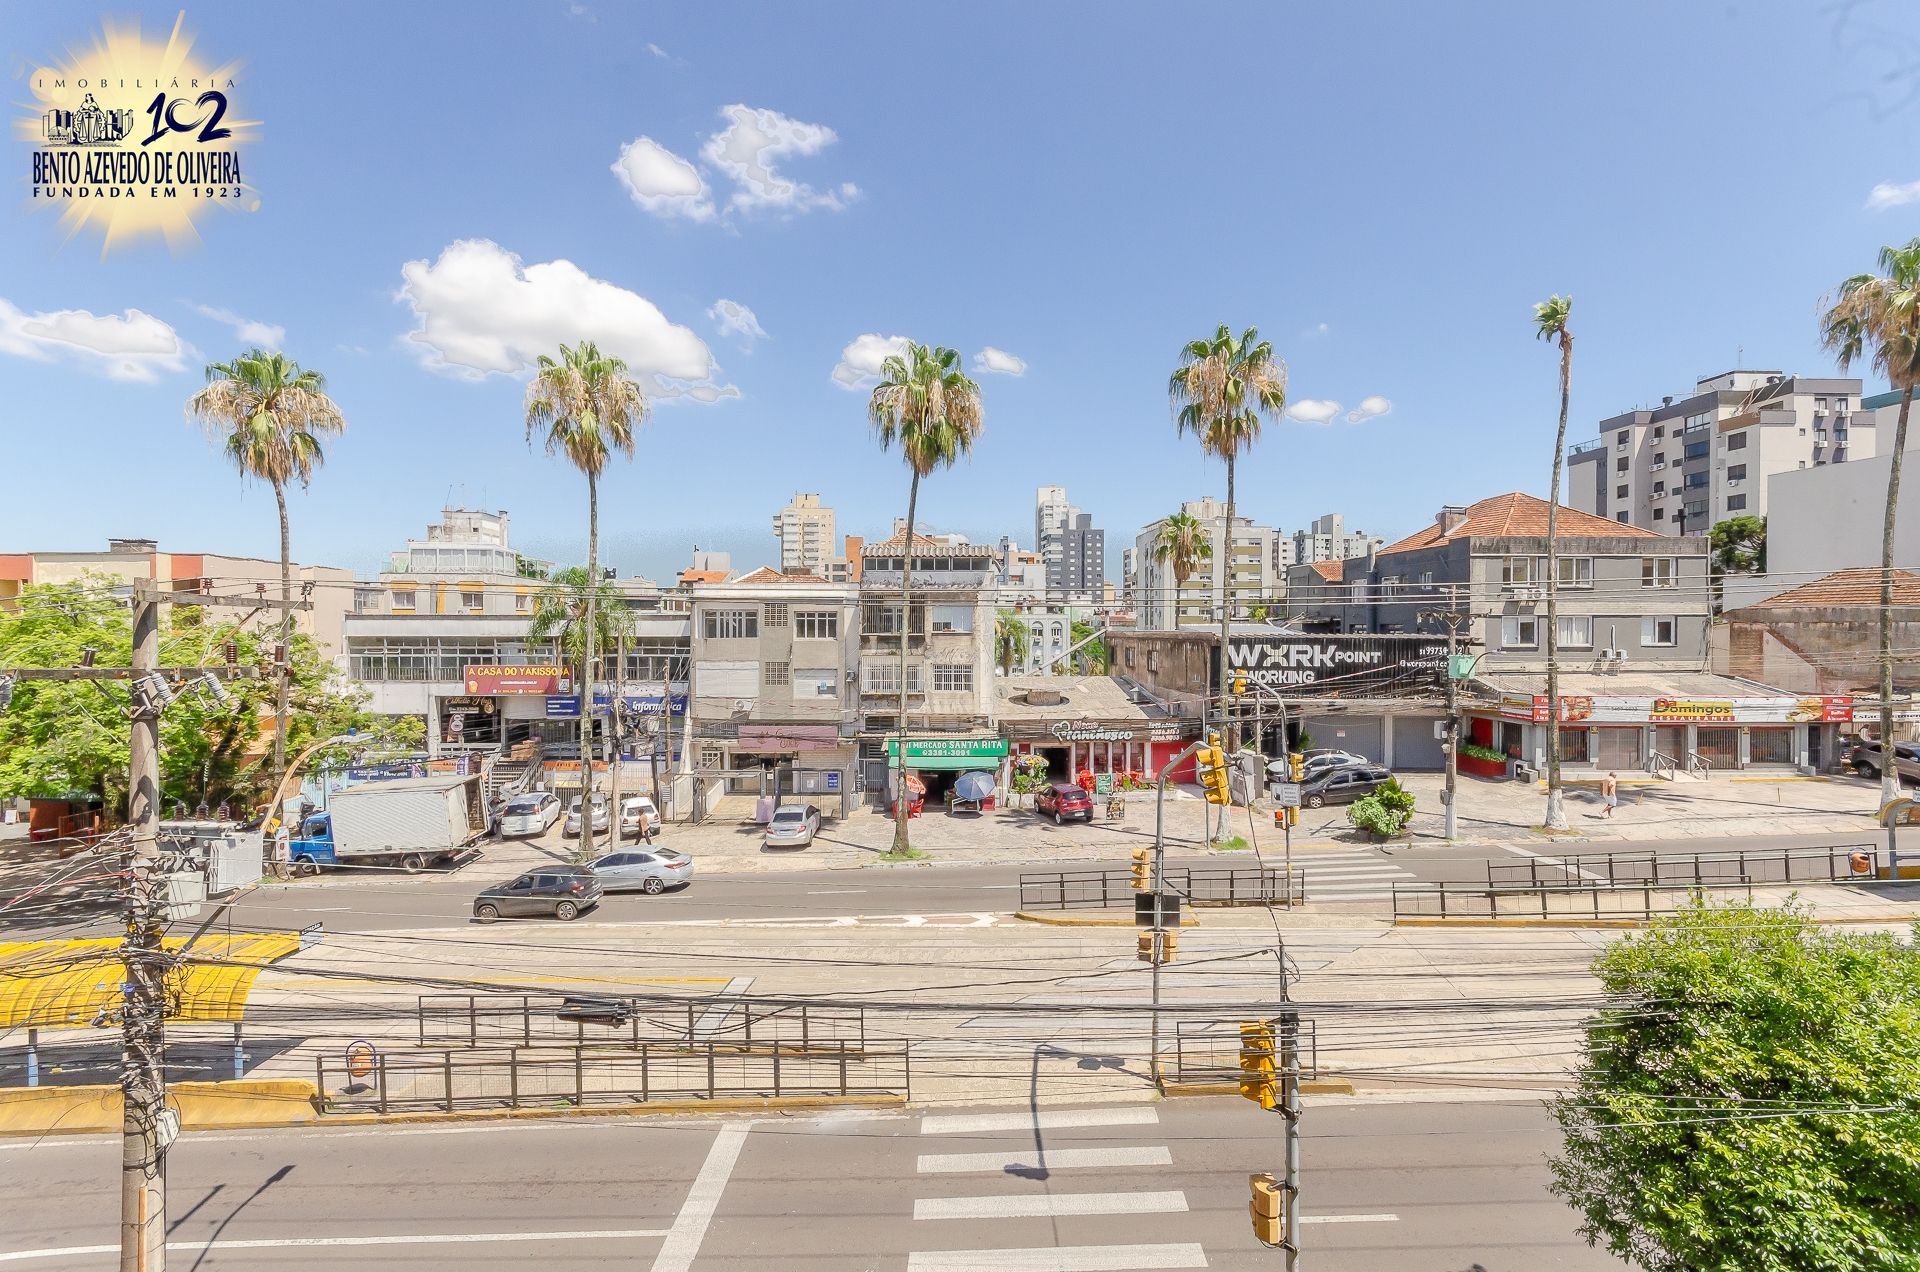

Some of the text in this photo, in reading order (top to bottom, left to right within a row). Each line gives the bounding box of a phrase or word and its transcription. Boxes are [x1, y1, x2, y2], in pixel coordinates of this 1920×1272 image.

[1335, 651, 1382, 664] POINT
[468, 667, 476, 676] A
[477, 667, 502, 676] CASA
[504, 667, 518, 676] DO
[1227, 670, 1315, 684] CWORKING
[1653, 699, 1730, 716] Domingos
[895, 741, 1003, 749] MI MERCADO SANTA RITA
